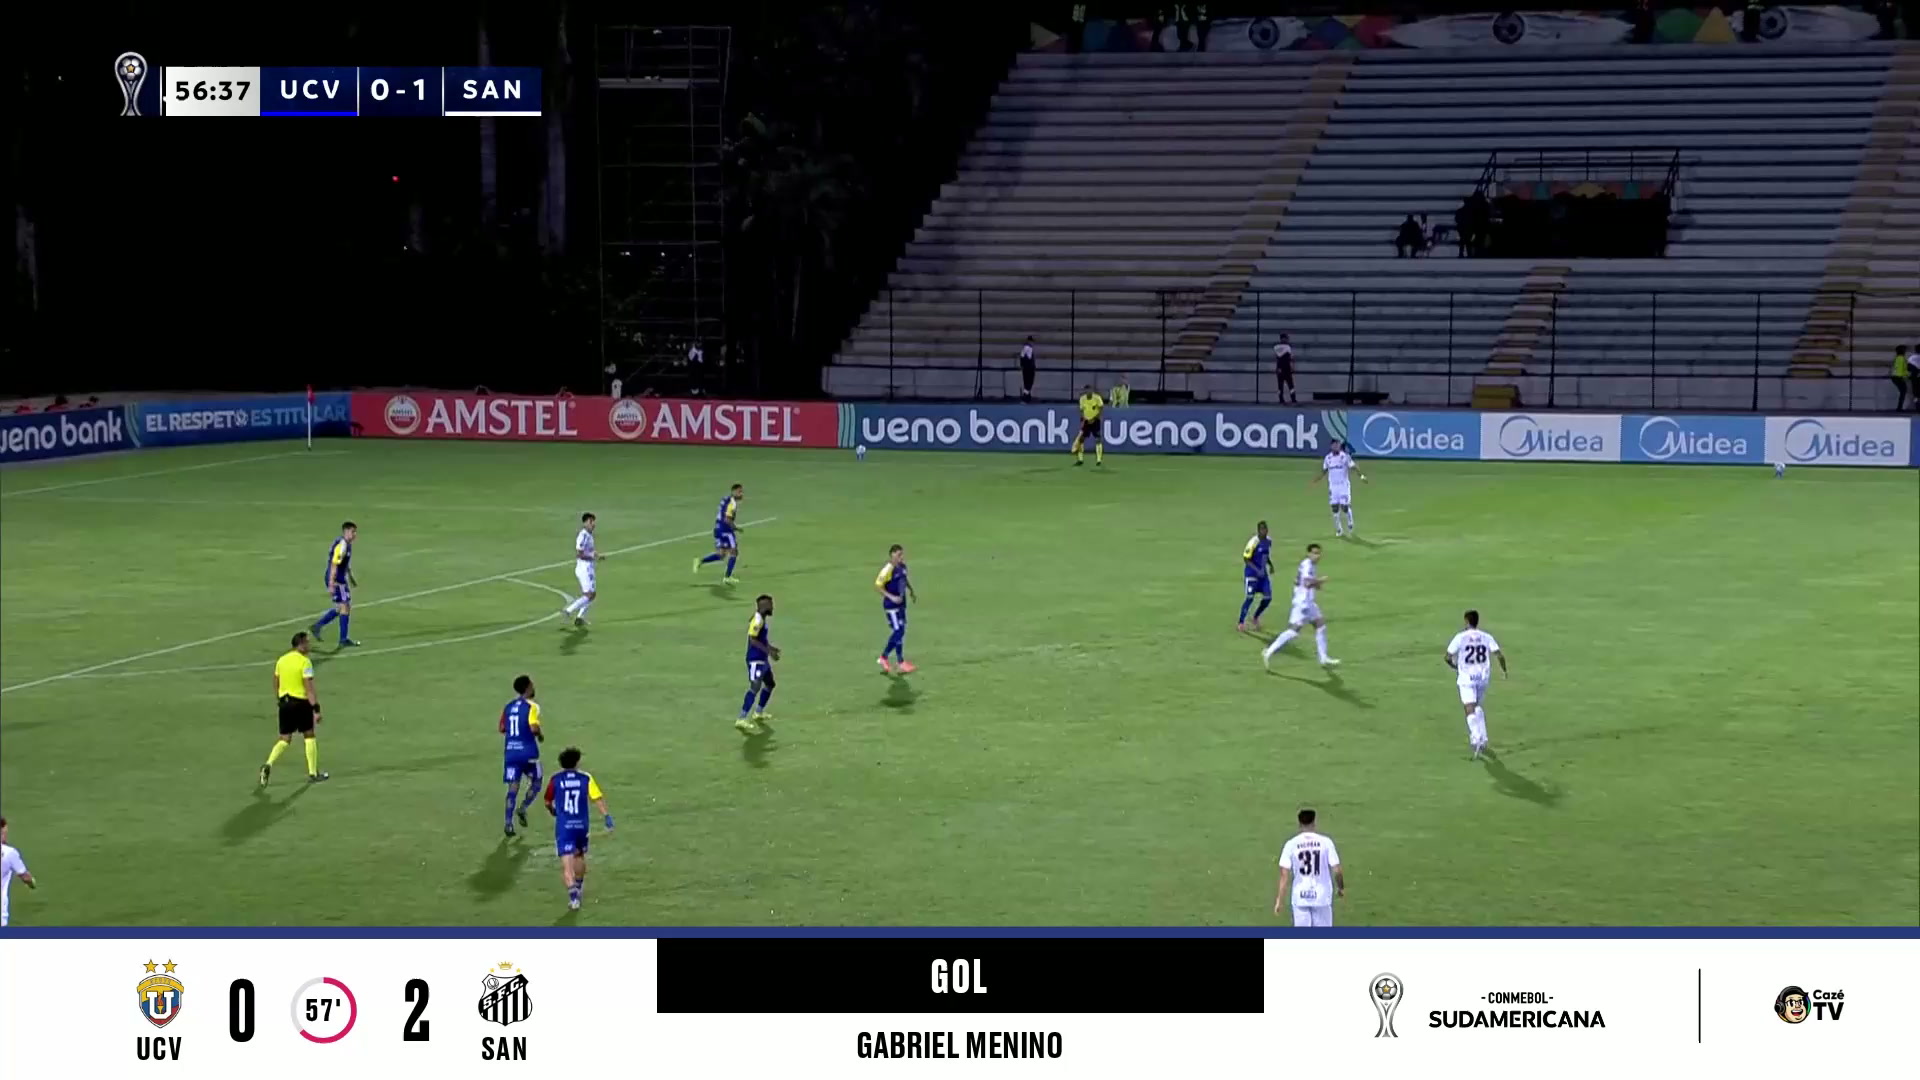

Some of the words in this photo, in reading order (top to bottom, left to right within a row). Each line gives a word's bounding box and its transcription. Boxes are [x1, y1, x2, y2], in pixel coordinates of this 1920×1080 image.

[60, 410, 122, 447] bank
[146, 414, 167, 432] EL
[251, 408, 272, 426] ES
[273, 404, 347, 425] TITULAR
[425, 398, 577, 437] AMSTEL
[650, 402, 802, 442] AMSTEL
[862, 415, 960, 443] ueno
[969, 409, 1069, 445] bank
[1103, 419, 1207, 447] ueno
[1215, 412, 1319, 449] bank
[1379, 427, 1464, 451] Midea
[1516, 428, 1603, 452] Midea
[1655, 430, 1747, 456] Midea
[1801, 432, 1895, 457] Midea
[1465, 644, 1487, 664] 28
[509, 715, 519, 736] 11
[564, 790, 580, 814] 47
[1298, 850, 1320, 875] 31
